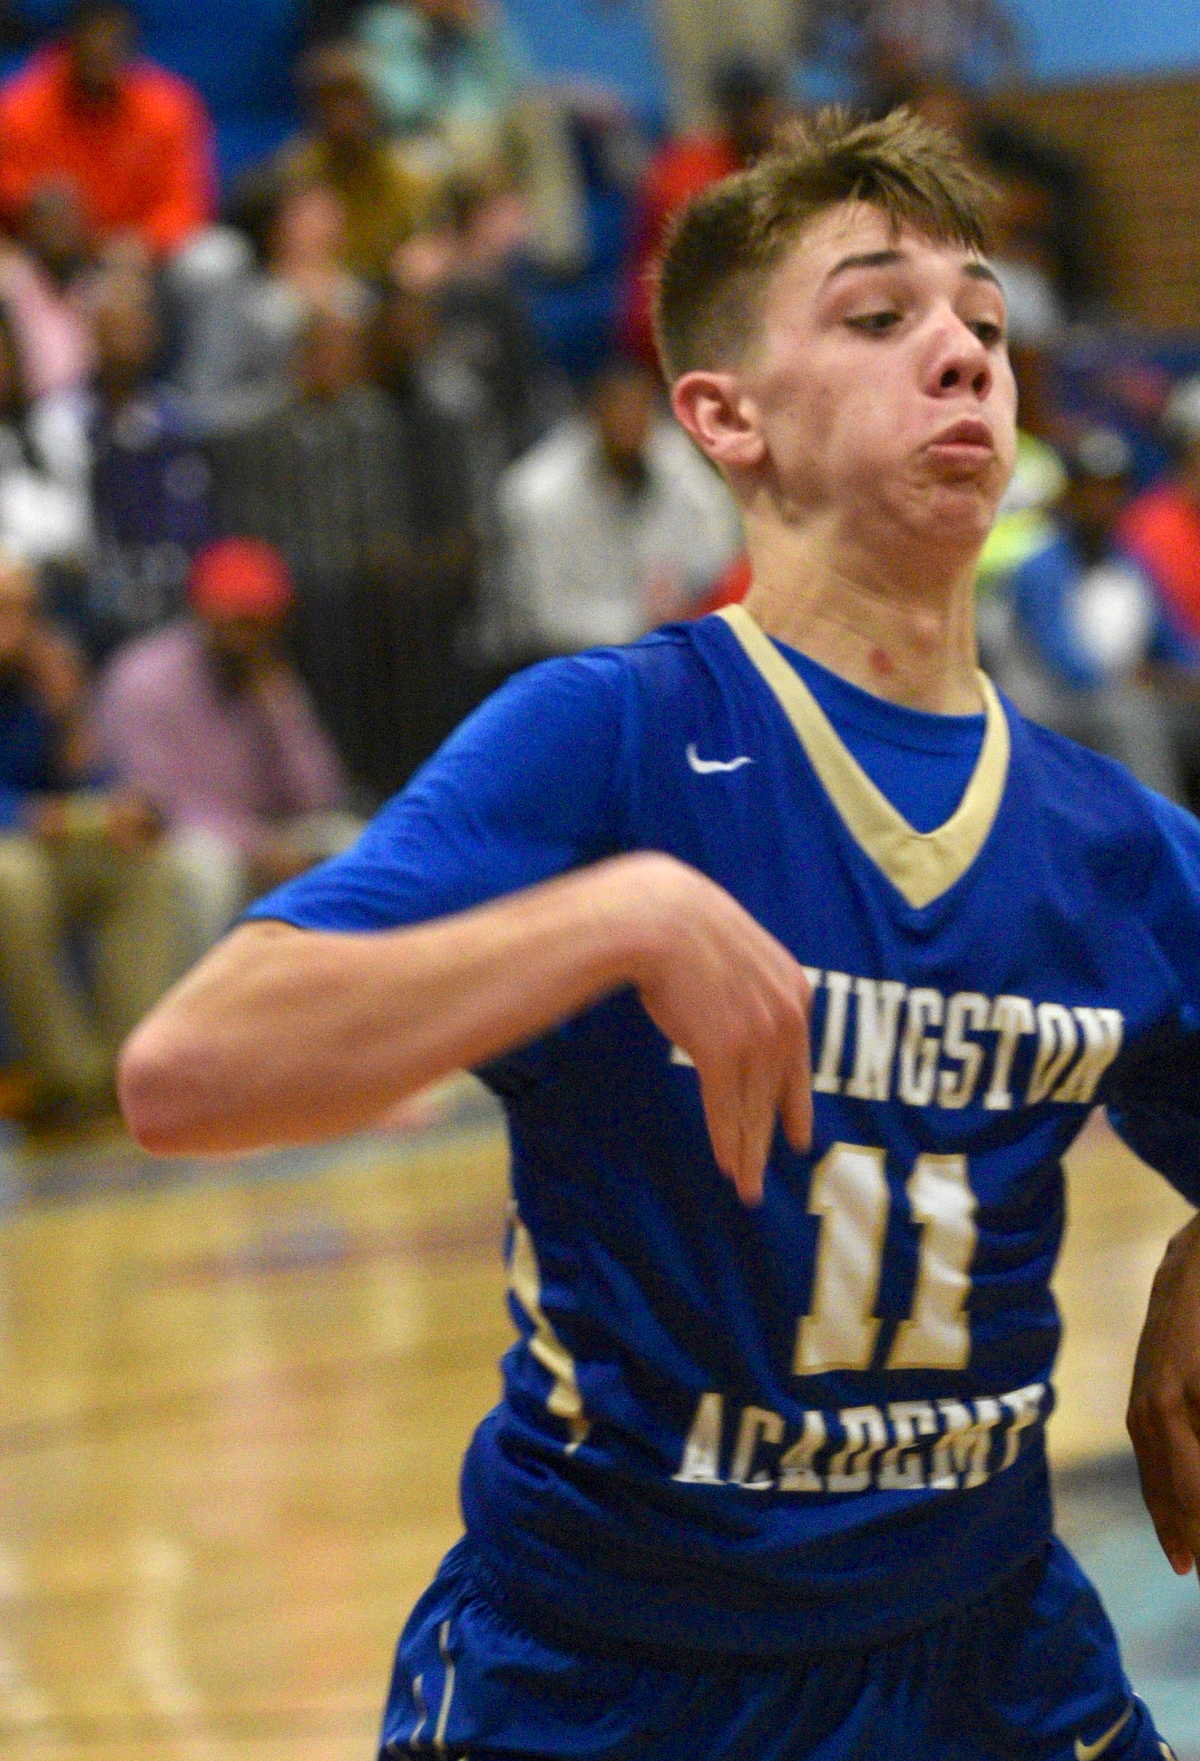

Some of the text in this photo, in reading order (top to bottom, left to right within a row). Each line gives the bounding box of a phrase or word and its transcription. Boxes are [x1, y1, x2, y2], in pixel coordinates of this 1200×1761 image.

[671, 964, 1124, 1110] INGSTON
[794, 1142, 978, 1375] 11
[672, 1383, 1046, 1493] ACADEMY
